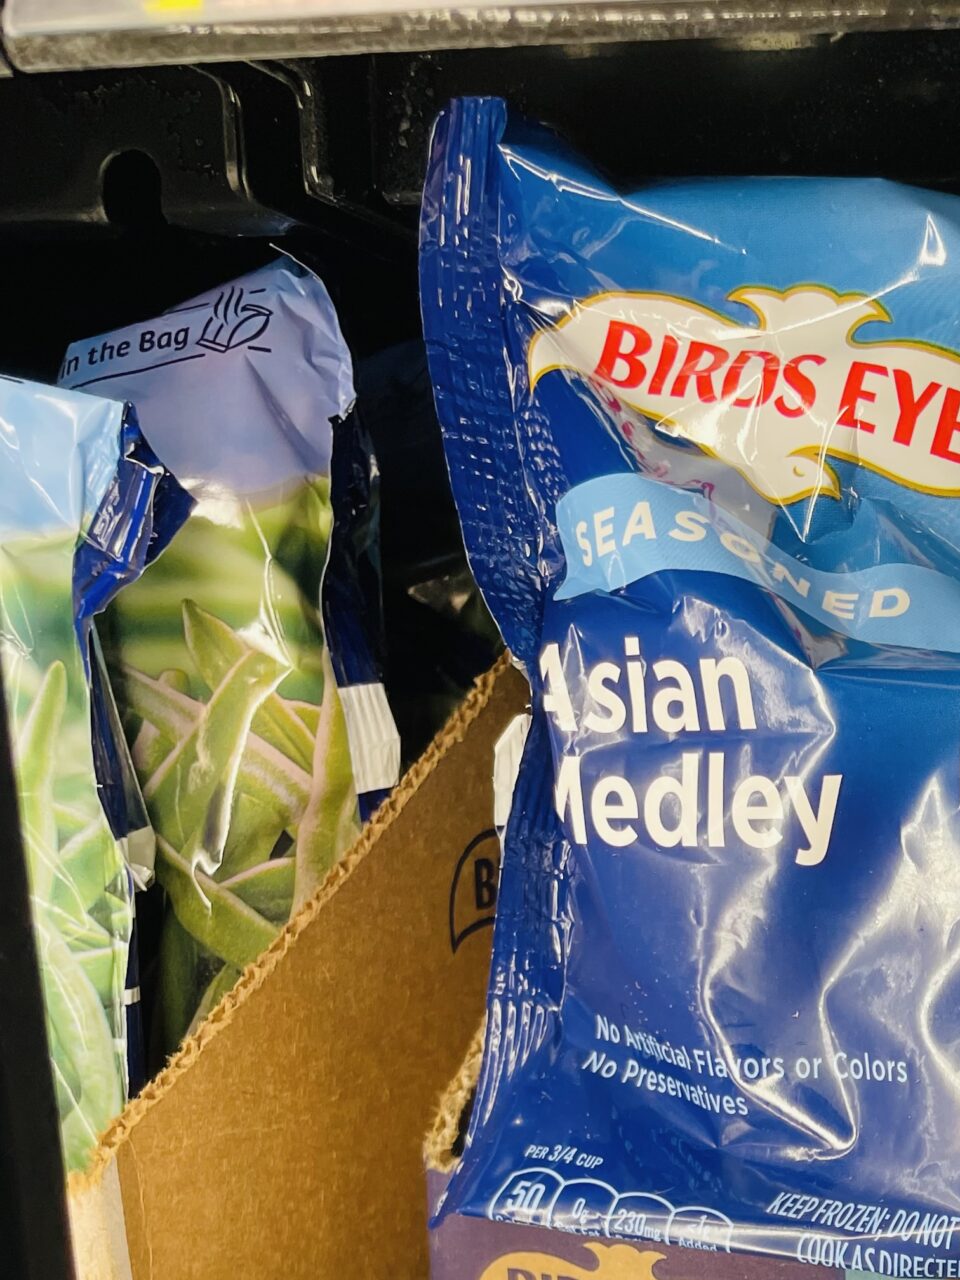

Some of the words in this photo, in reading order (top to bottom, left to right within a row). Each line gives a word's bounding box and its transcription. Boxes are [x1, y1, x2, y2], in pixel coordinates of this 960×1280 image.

[88, 341, 130, 366] the
[139, 327, 190, 351] Bag
[594, 319, 828, 419] BIRDS
[576, 500, 910, 619] SEASONED
[596, 1014, 620, 1043] No
[624, 1024, 691, 1071] Artificial
[693, 1049, 785, 1081] Flavors
[796, 1056, 822, 1079] or
[834, 1052, 908, 1083] Colors
[582, 1051, 618, 1079] No
[622, 1059, 749, 1116] Preservatives
[524, 1145, 547, 1160] PER
[548, 1145, 575, 1165] 3/4
[576, 1153, 604, 1169] CUP
[507, 1180, 545, 1213] 50
[766, 1192, 818, 1222] KEEP
[886, 1209, 920, 1243] DO
[921, 1213, 959, 1250] NOT
[613, 1208, 662, 1242] 230mg
[797, 1232, 848, 1269] COOK
[850, 1244, 876, 1273] AS
